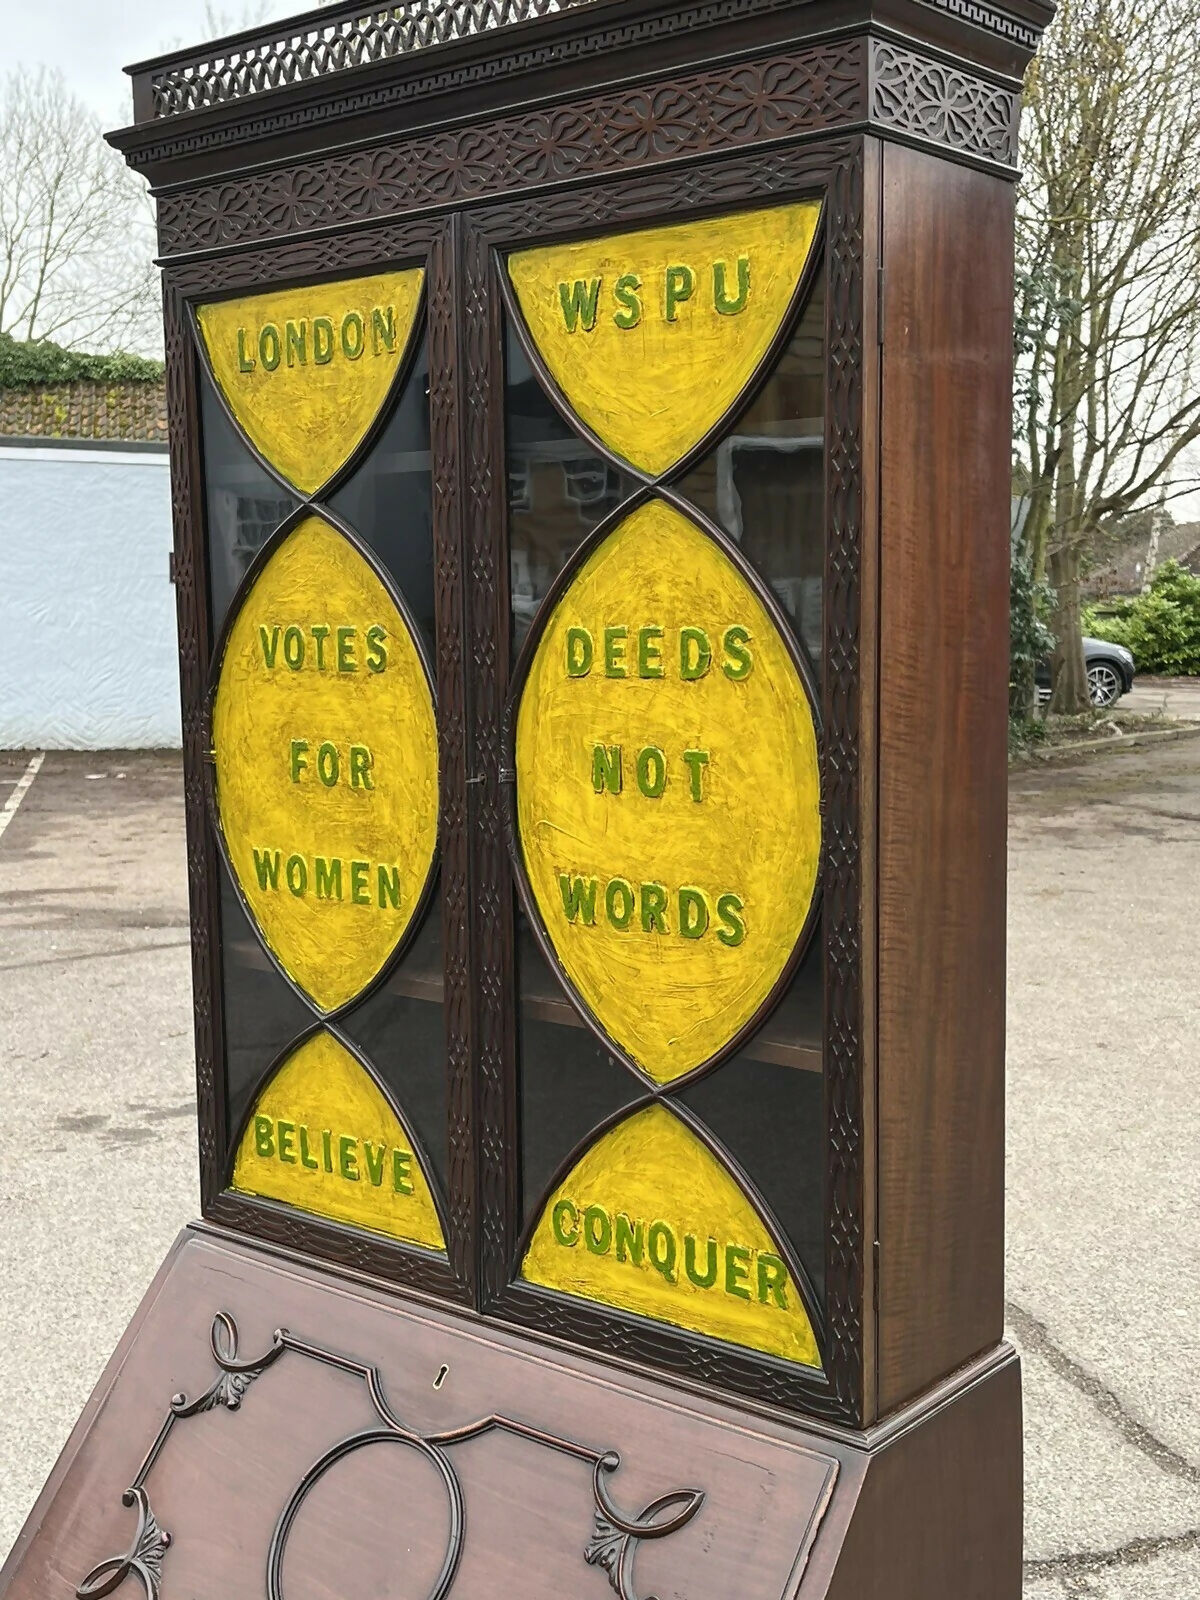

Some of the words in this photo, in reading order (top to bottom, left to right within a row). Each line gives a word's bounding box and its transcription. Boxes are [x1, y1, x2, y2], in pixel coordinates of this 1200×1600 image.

[560, 259, 751, 332] WSPU
[238, 302, 397, 373] LONDON
[260, 624, 388, 673] VOTES
[567, 626, 752, 680] DEEDS
[291, 740, 373, 790] FOR
[592, 744, 708, 802] NOT
[254, 848, 400, 909] WOMEN
[560, 875, 744, 946] WORDS
[255, 1115, 415, 1195] BELIEVE
[552, 1202, 789, 1310] CONQUER
